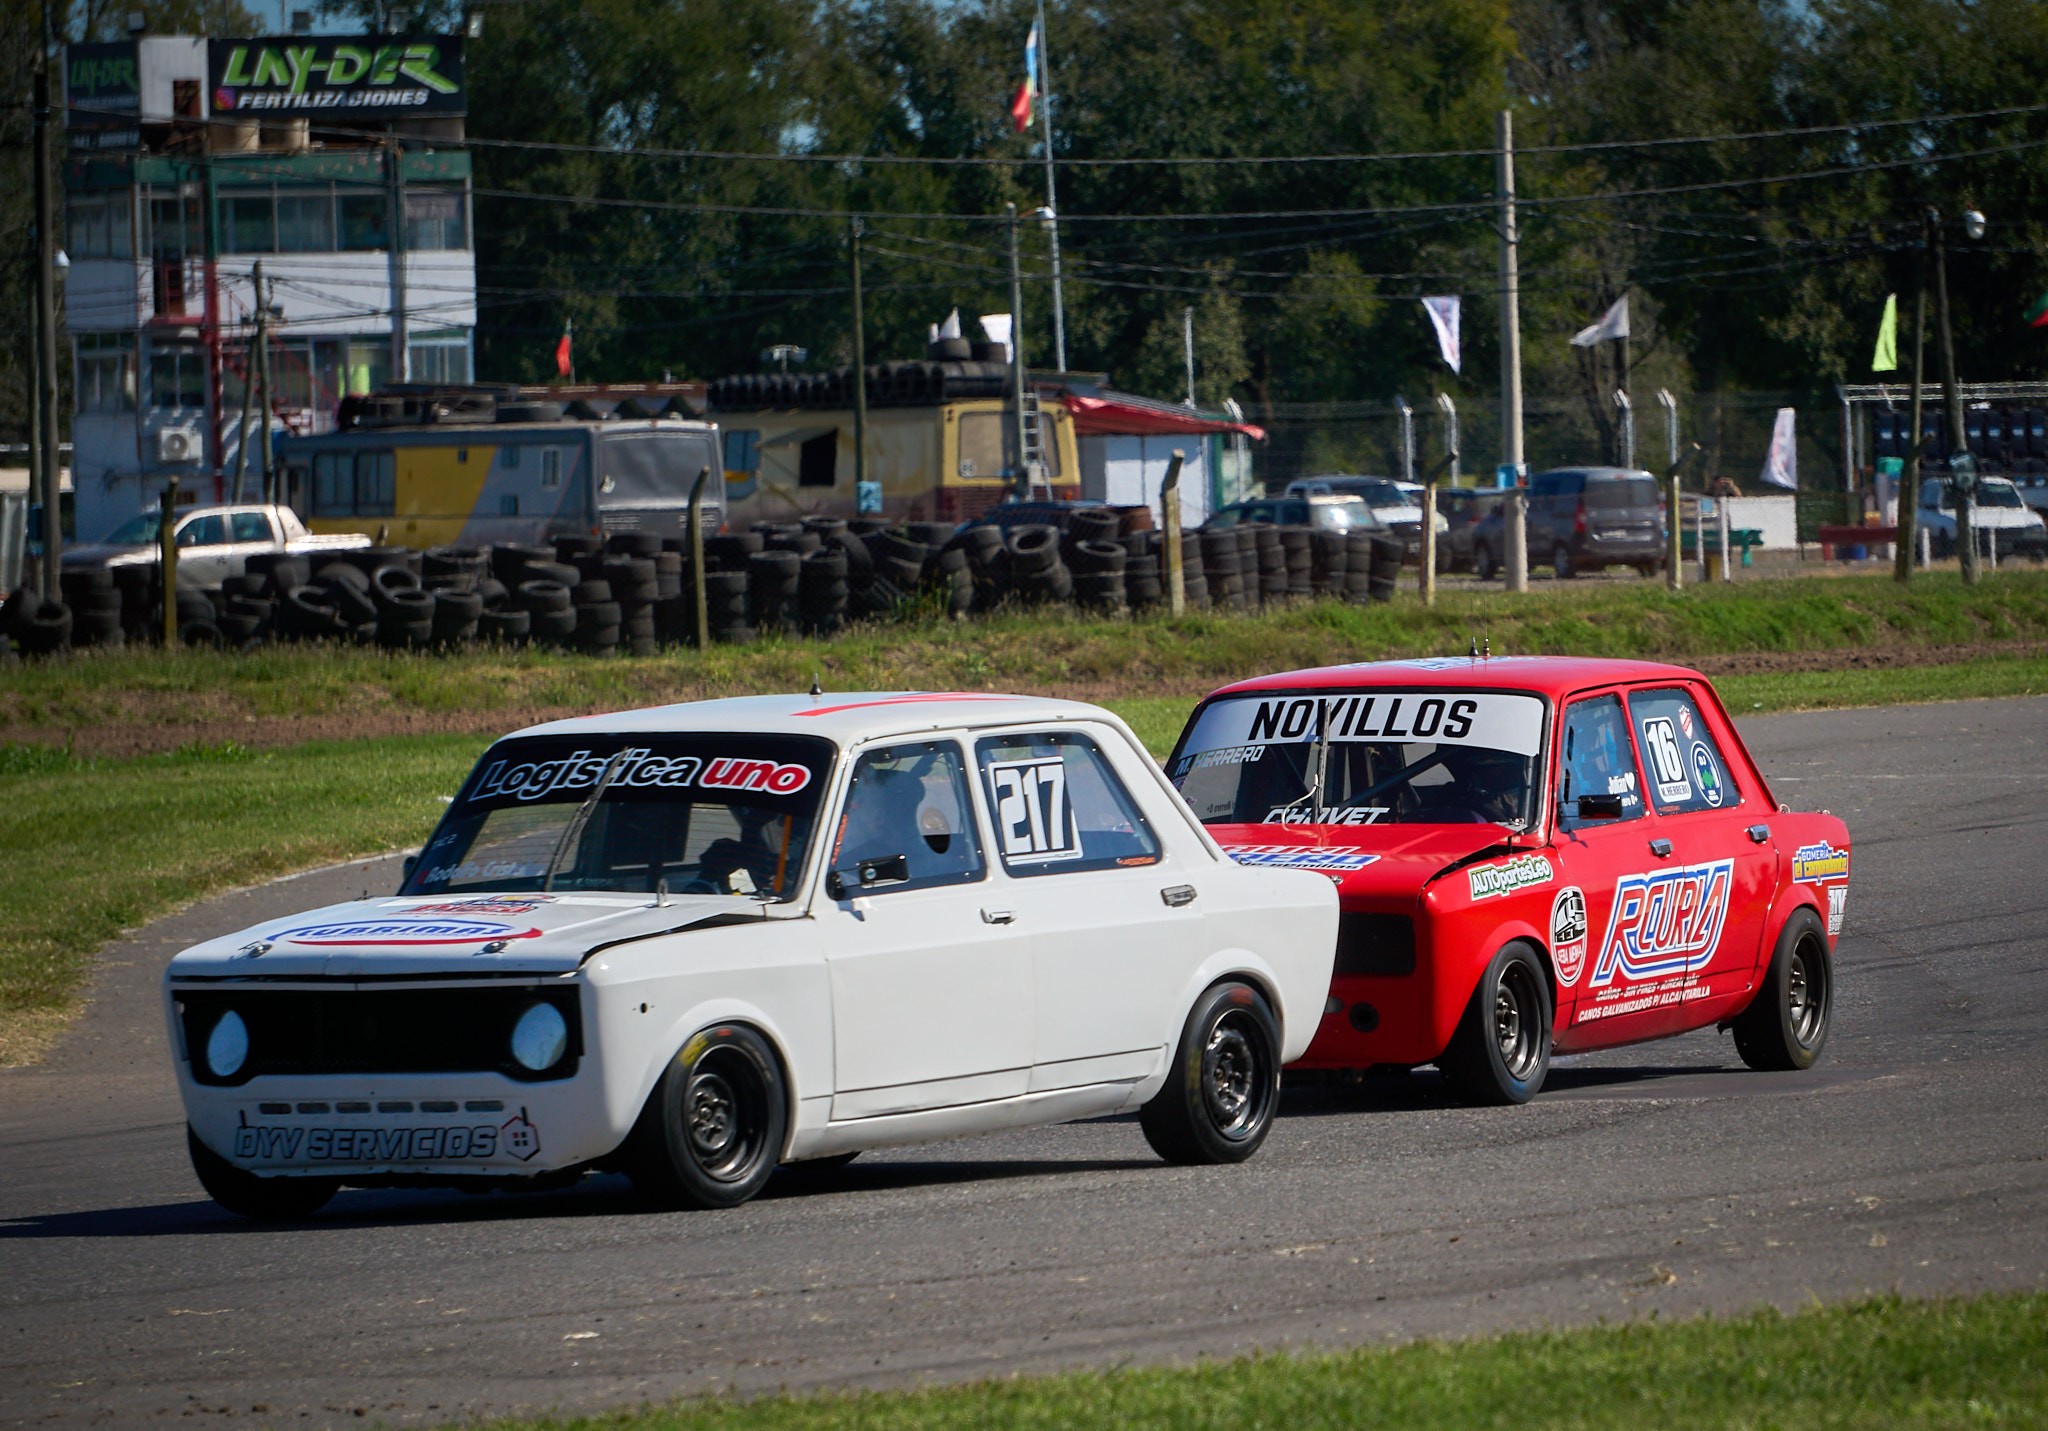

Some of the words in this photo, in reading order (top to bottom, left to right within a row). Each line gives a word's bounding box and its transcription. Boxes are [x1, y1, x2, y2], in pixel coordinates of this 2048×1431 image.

[1248, 697, 1478, 741] NOVILLOS
[1191, 745, 1266, 769] HERRERO
[1648, 721, 1683, 782] 16
[469, 747, 702, 802] Logistica
[698, 758, 812, 794] uno
[995, 764, 1065, 855] 217
[1602, 997, 1653, 1017] GALVANIZADOS
[308, 1126, 497, 1160] SERVICIOS
